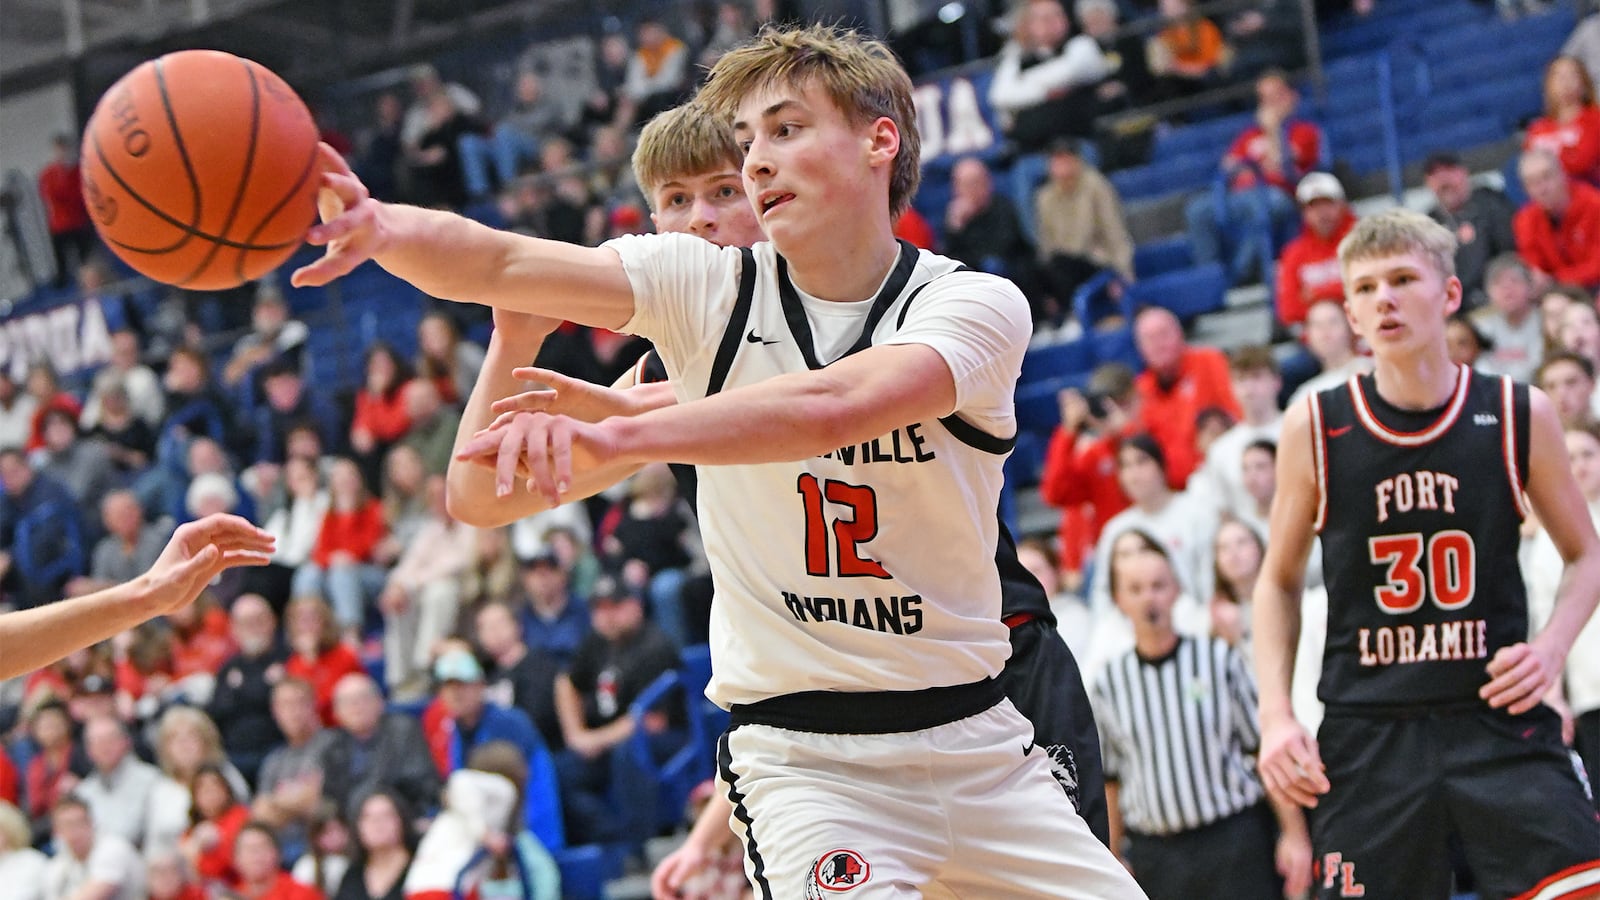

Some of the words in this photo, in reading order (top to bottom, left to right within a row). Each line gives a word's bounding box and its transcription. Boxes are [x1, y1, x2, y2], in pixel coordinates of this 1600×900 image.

[816, 422, 936, 466] VILLE
[1375, 470, 1459, 523] FORT
[797, 473, 893, 579] 12
[1368, 529, 1476, 615] 30
[781, 591, 923, 635] INDIANS
[1358, 619, 1488, 666] LORAMIE
